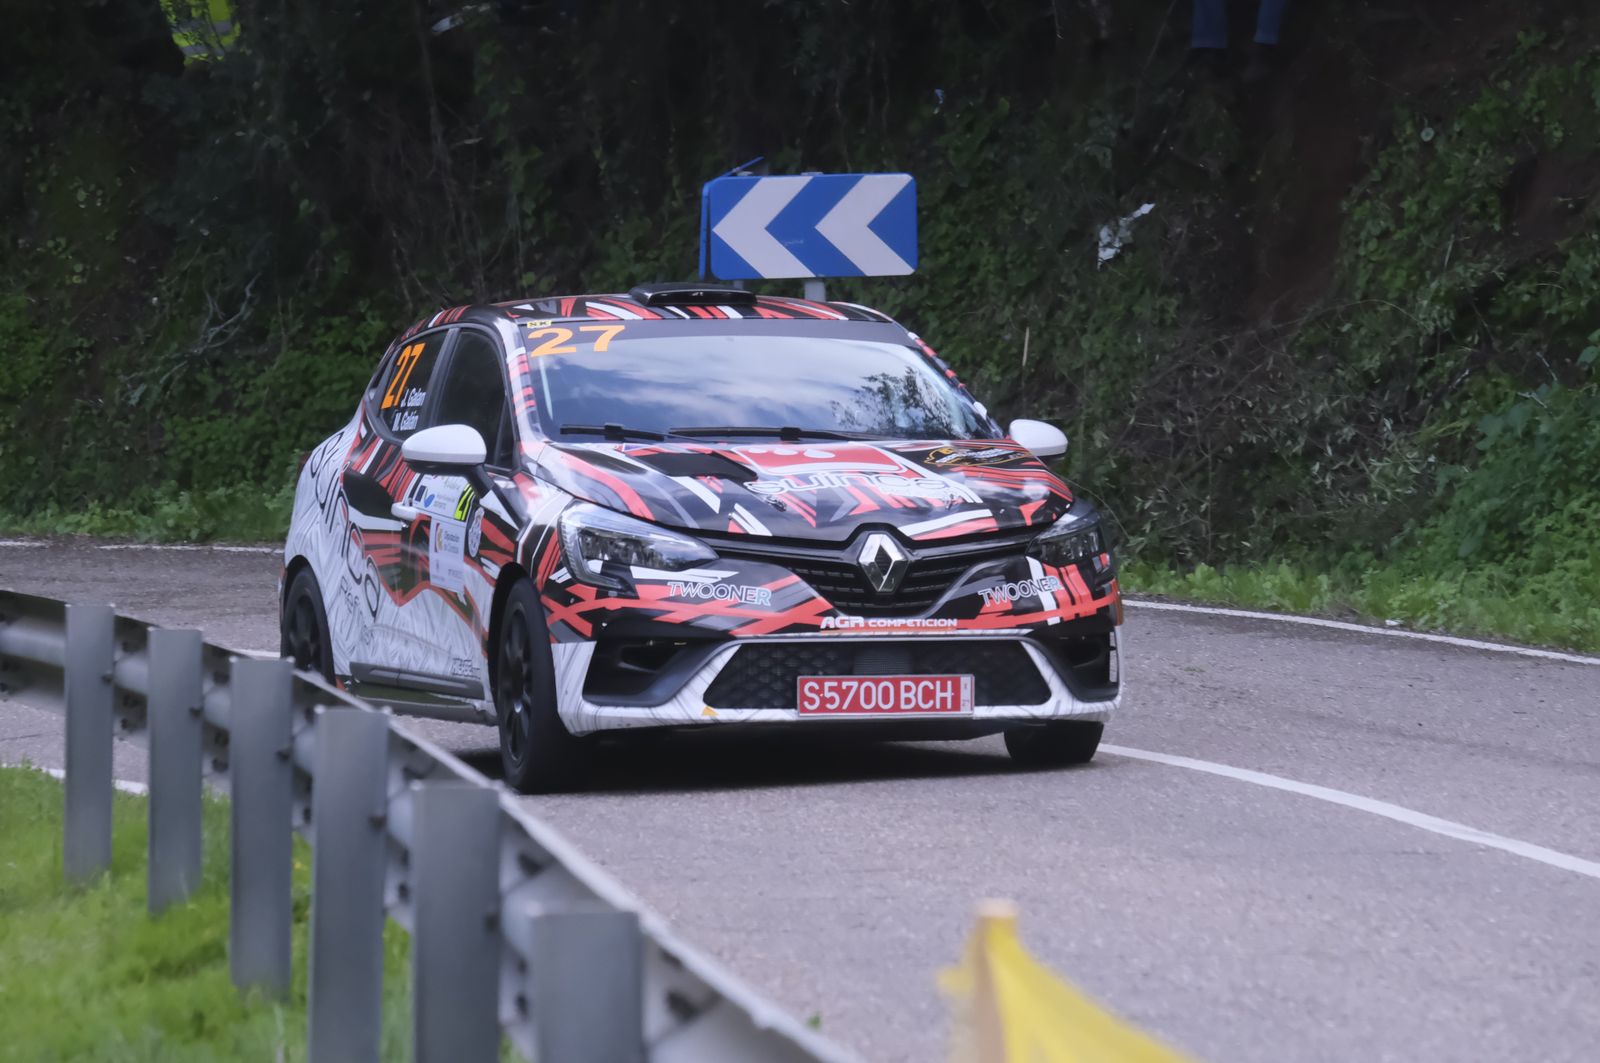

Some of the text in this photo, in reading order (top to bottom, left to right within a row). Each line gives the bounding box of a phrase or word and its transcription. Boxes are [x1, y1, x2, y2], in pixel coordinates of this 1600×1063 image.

[527, 325, 625, 358] 27
[381, 343, 426, 409] 27
[667, 581, 772, 607] TWOONER
[978, 575, 1066, 607] TWOONER
[868, 618, 957, 628] COMPETICION
[803, 681, 895, 711] S5700
[899, 680, 952, 710] BCH
